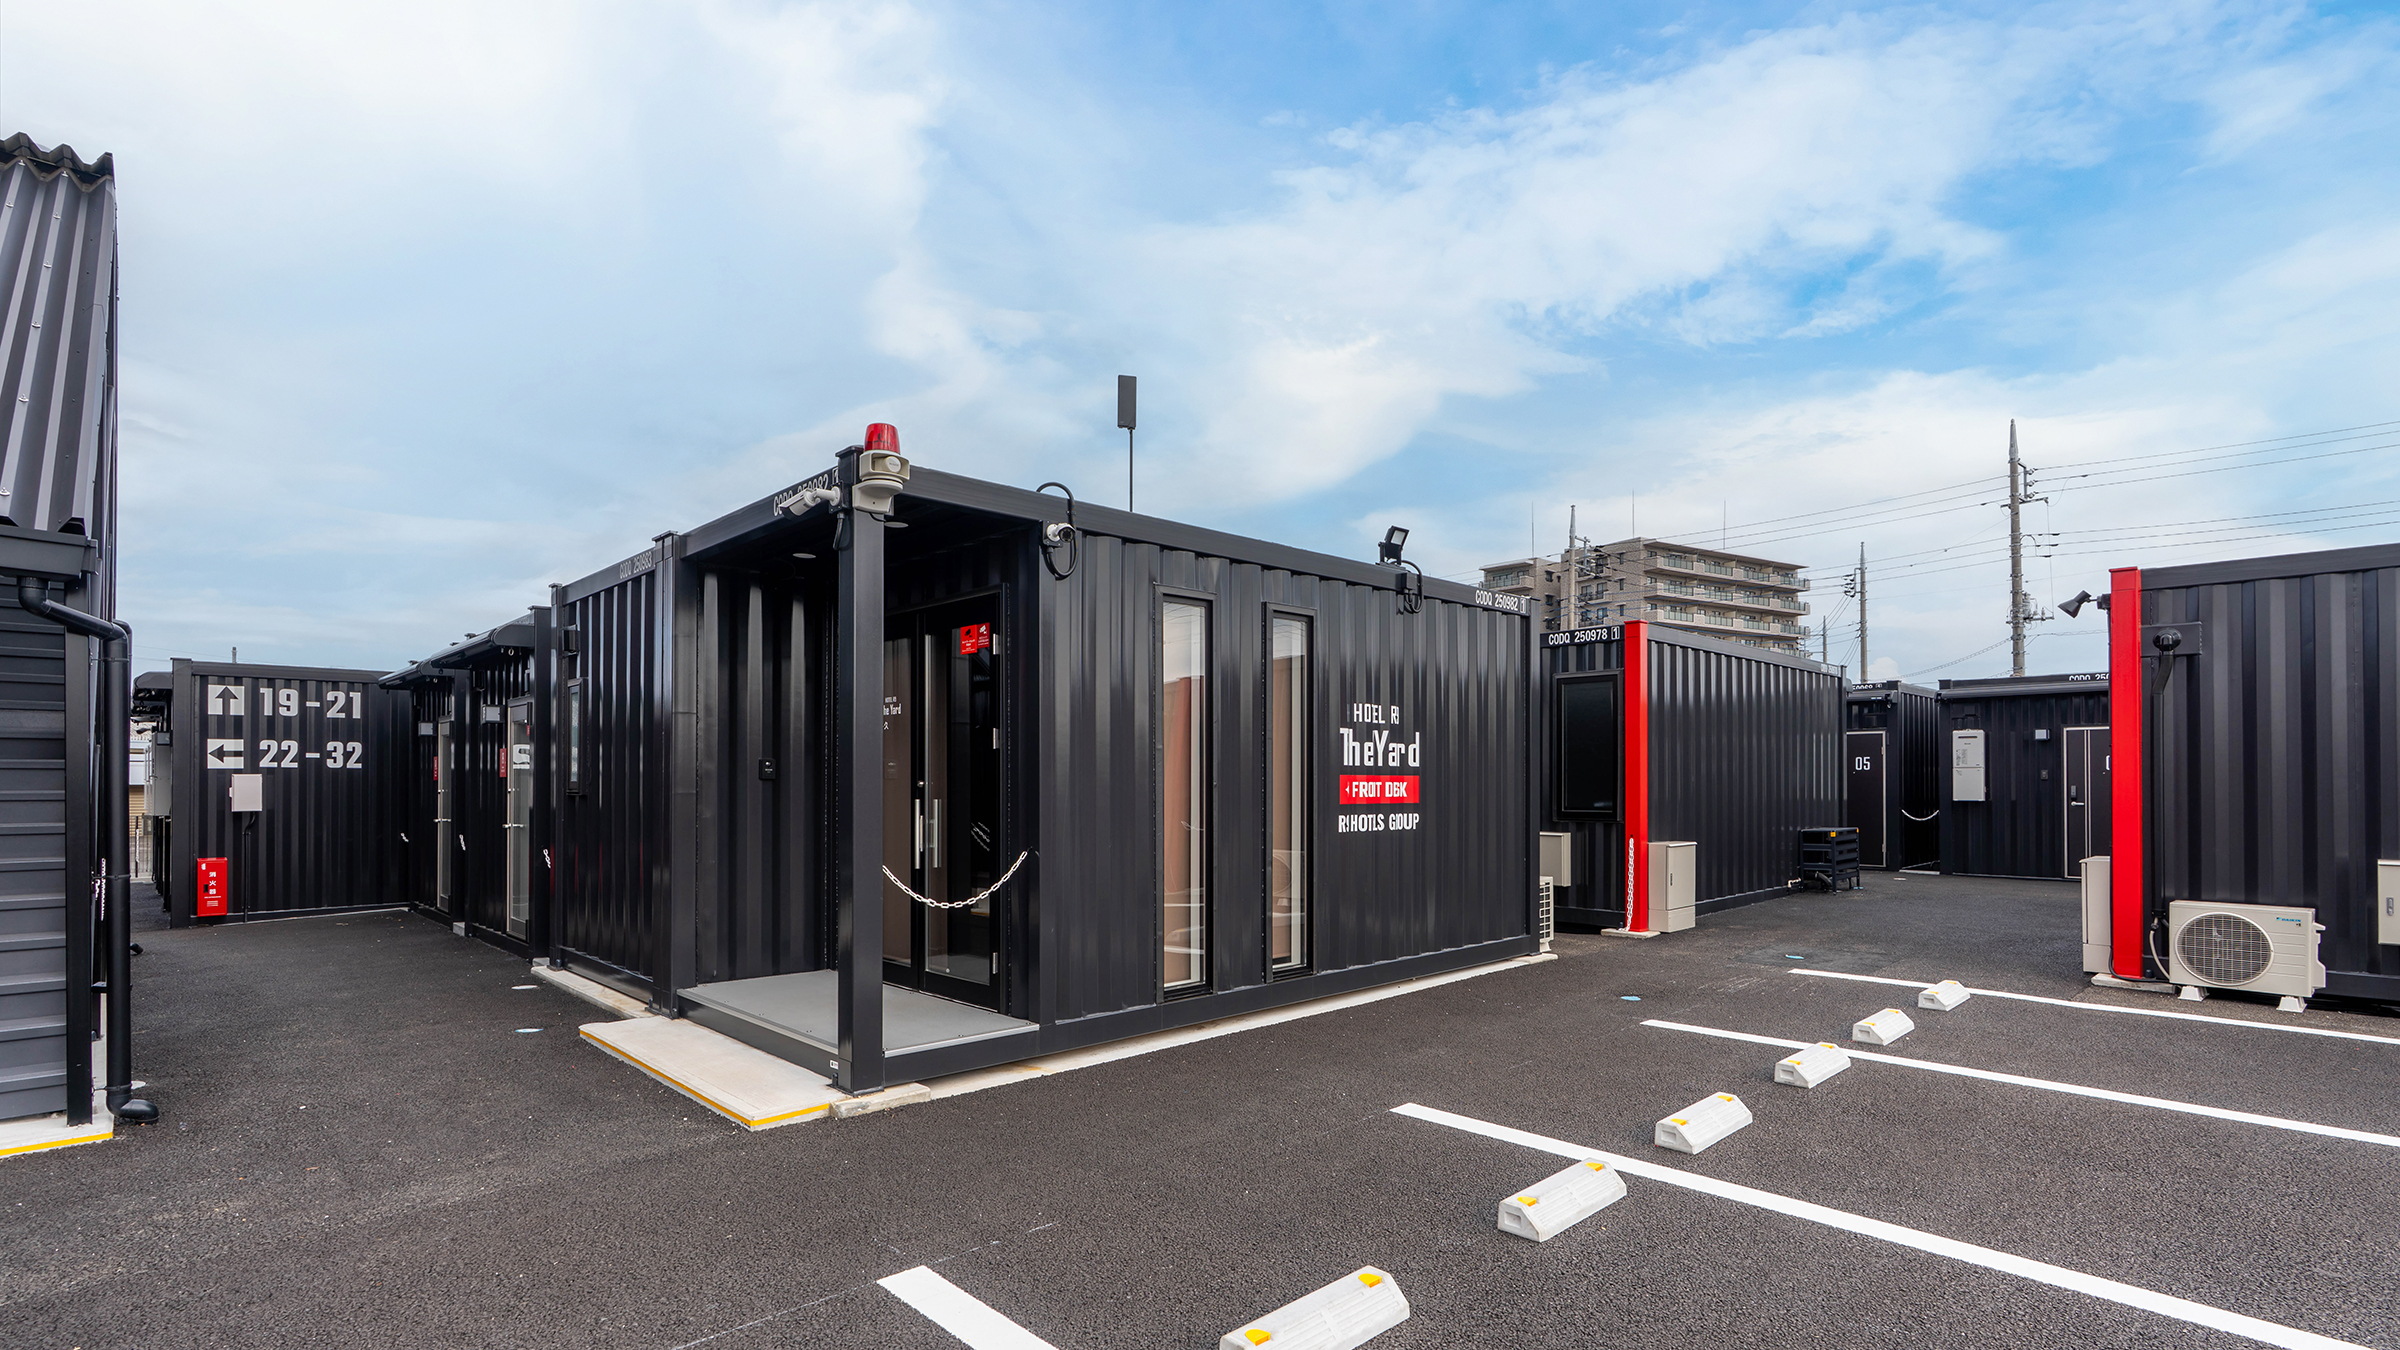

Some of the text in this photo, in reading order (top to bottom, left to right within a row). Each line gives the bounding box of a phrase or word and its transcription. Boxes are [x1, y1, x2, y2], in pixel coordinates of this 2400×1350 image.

[1475, 590, 1493, 606] CODQ
[1494, 593, 1518, 611] 250982
[1548, 632, 1570, 645] CODQ
[1574, 628, 1608, 643] 250978
[1855, 756, 1871, 771] 05
